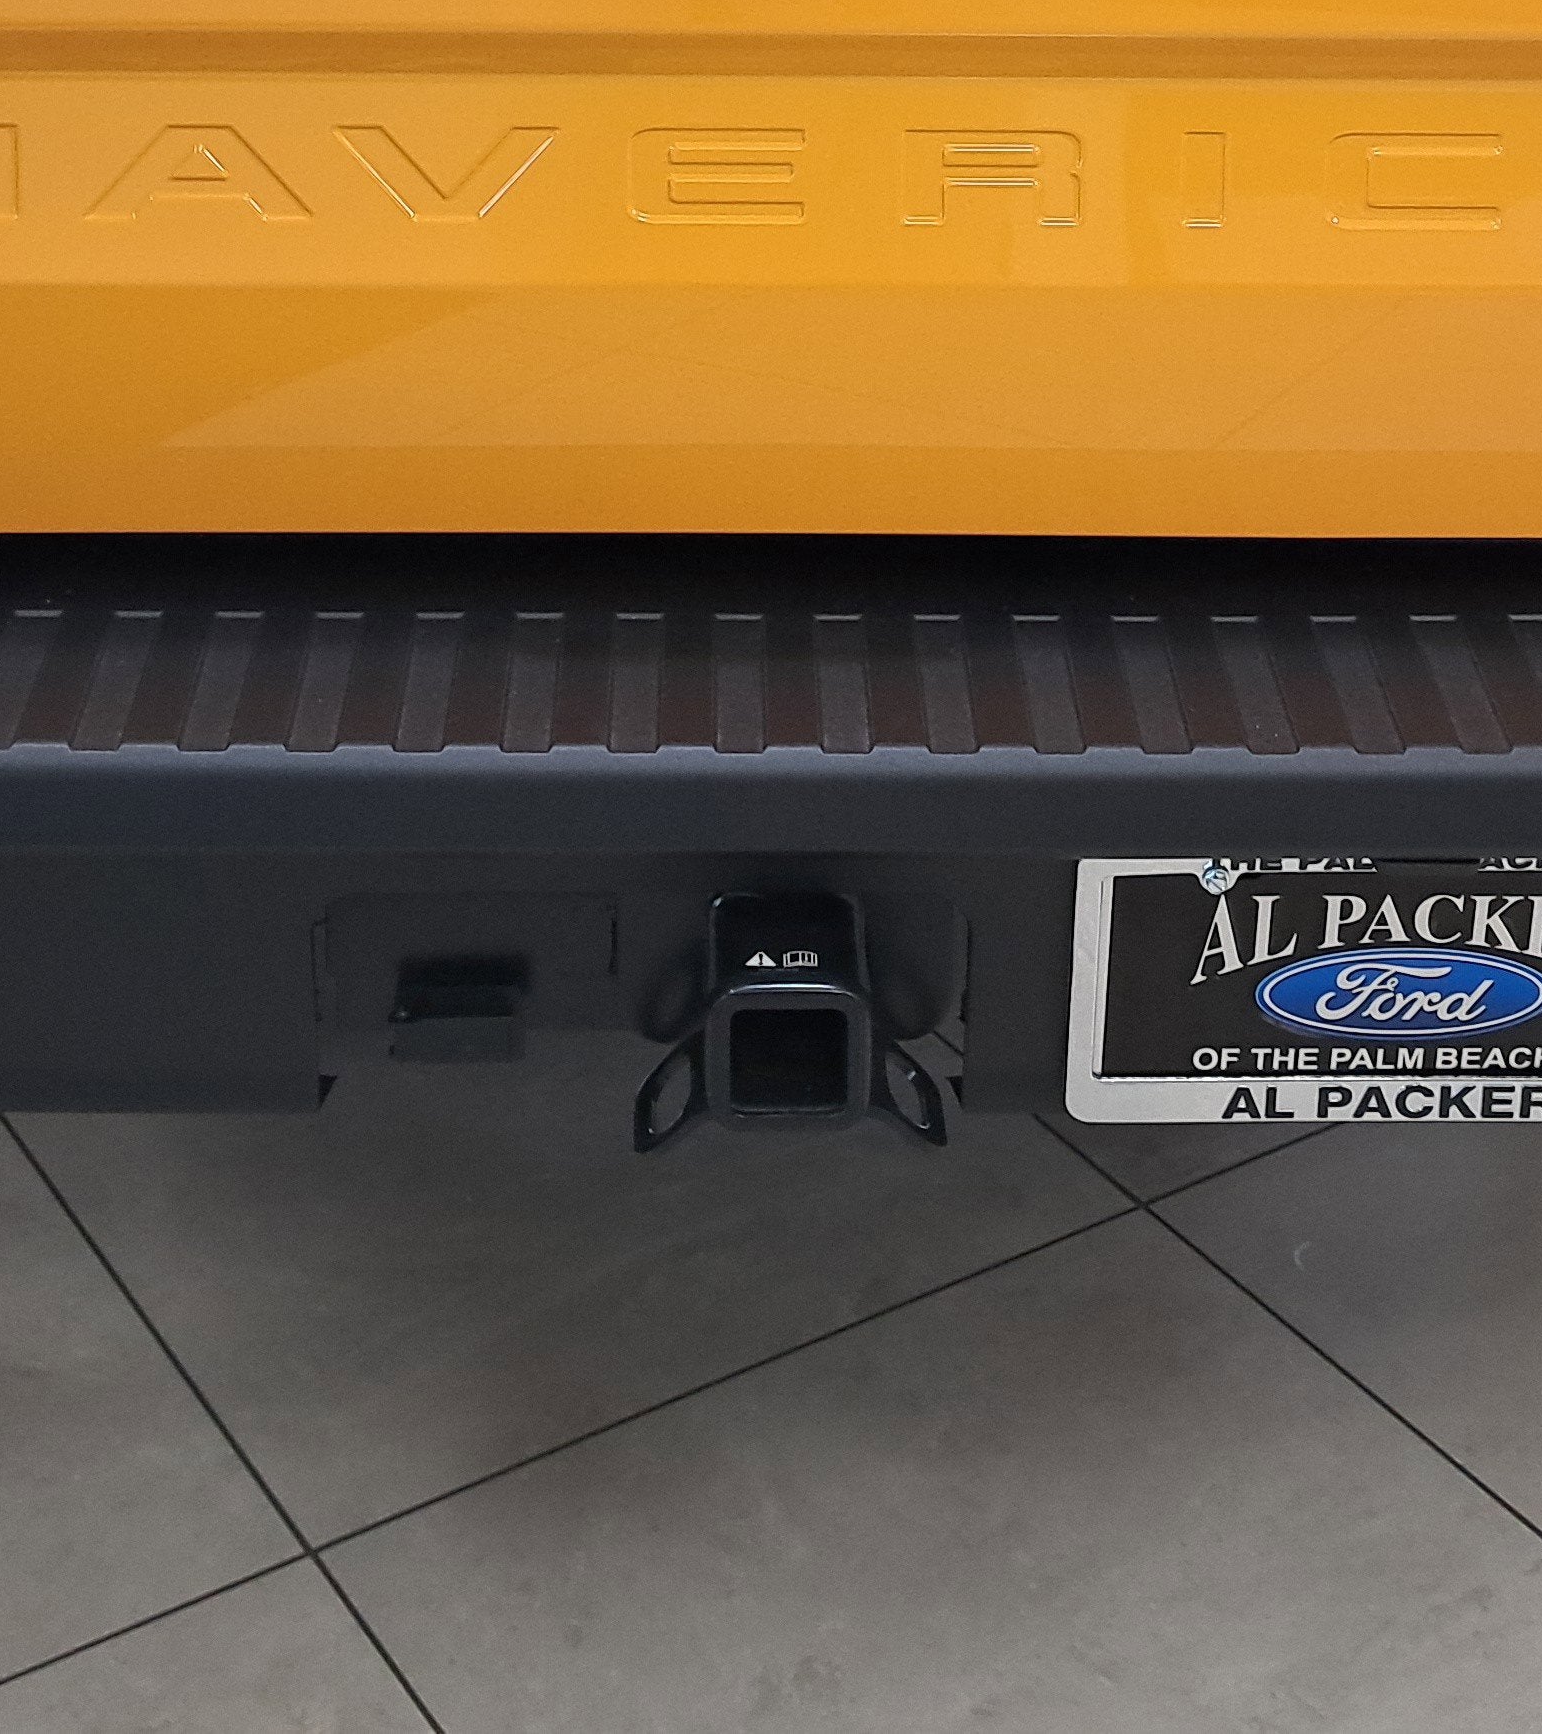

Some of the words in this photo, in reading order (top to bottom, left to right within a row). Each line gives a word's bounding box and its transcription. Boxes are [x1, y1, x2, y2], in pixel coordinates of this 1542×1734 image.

[1190, 894, 1297, 985] AL
[1315, 963, 1494, 1023] Ford
[1192, 1047, 1241, 1070] OF
[1251, 1047, 1319, 1070] THE
[1330, 1047, 1424, 1070] PALM
[1222, 1086, 1294, 1119] AL
